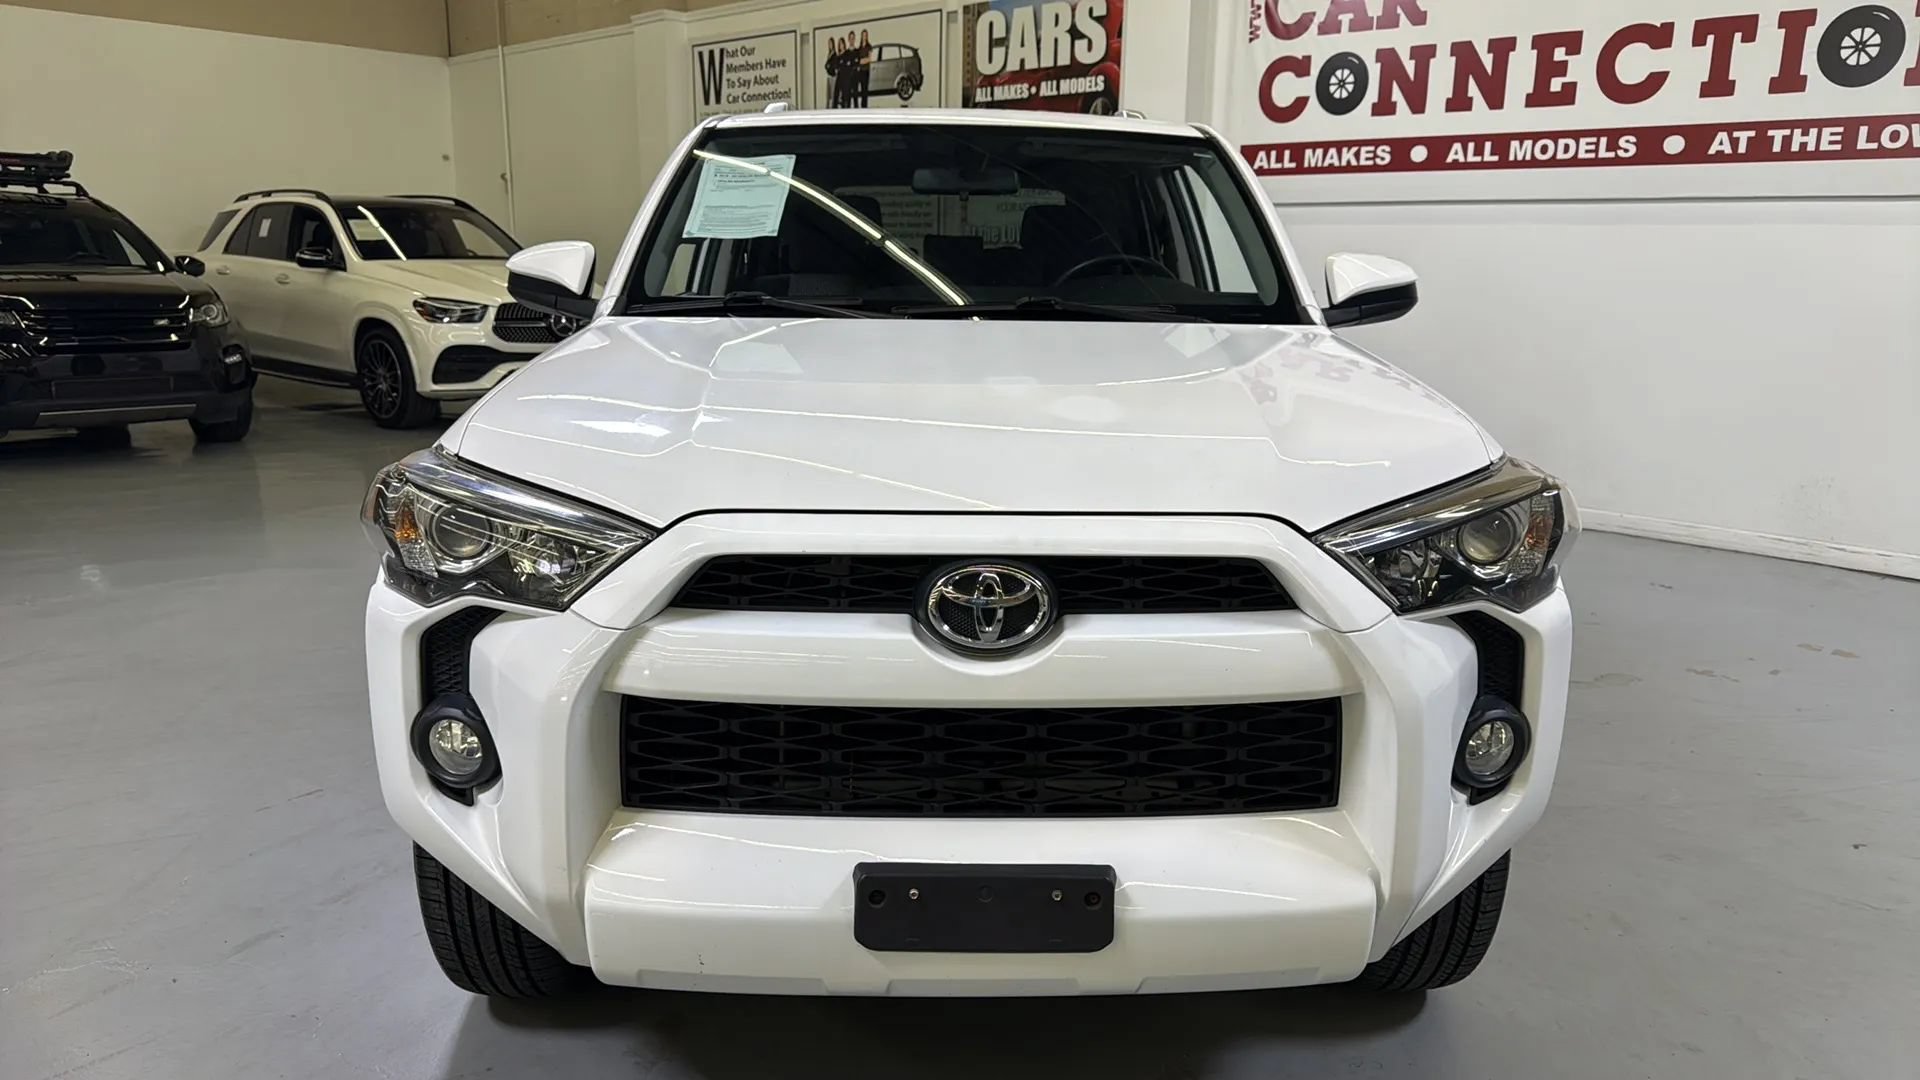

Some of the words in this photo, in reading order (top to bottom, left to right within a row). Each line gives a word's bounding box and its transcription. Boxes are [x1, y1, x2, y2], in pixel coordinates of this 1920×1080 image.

[976, 0, 1107, 75] CARS
[740, 46, 755, 57] Our
[726, 60, 764, 74] Members
[765, 58, 787, 70] Have
[1258, 4, 1920, 124] CONNECTIO
[726, 78, 736, 89] To
[737, 76, 752, 90] Say
[753, 75, 779, 87] About
[975, 86, 993, 103] ALL
[993, 82, 1029, 100] MAKES
[1039, 79, 1058, 97] ALL
[1059, 74, 1105, 95] MODELS
[726, 93, 740, 105] Car
[741, 88, 791, 103] Connection!
[1253, 149, 1297, 170] ALL
[1303, 144, 1392, 168] MAKES
[1445, 140, 1492, 164] ALL
[1508, 134, 1638, 161] MODELS
[1707, 130, 1756, 155] AT
[1767, 126, 1844, 153] THE
[1856, 123, 1920, 150] LO
